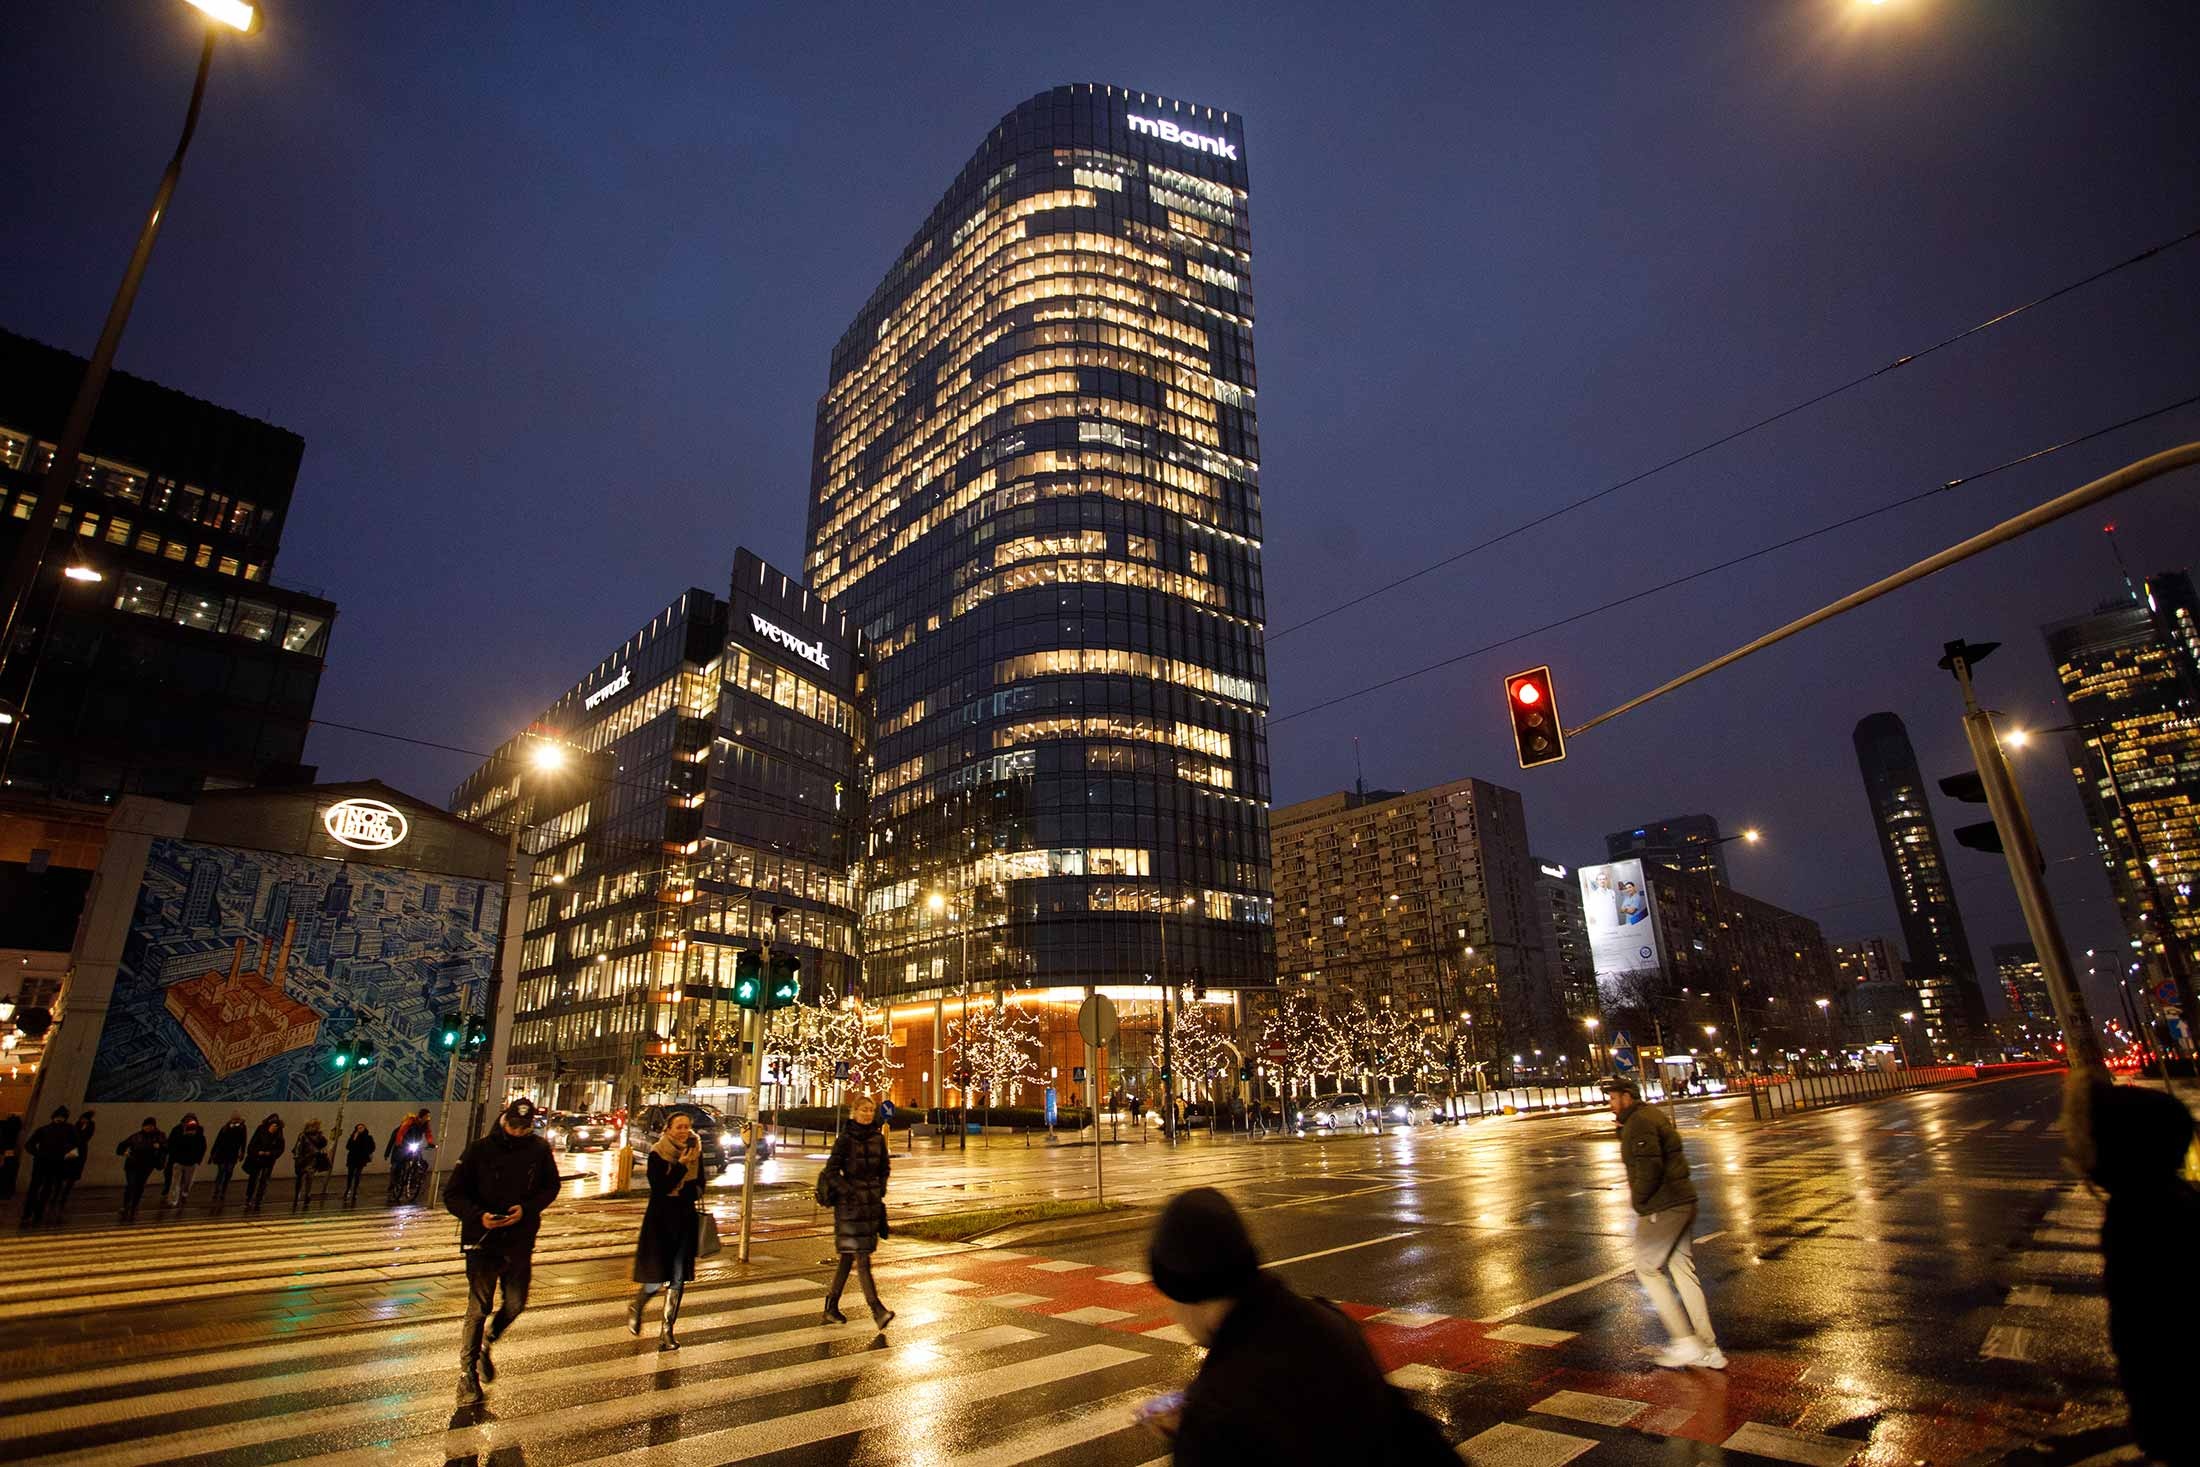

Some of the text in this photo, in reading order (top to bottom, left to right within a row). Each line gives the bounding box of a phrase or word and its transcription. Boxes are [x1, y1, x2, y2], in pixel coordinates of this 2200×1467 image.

[1127, 114, 1237, 161] mBank
[750, 613, 830, 671] wework
[585, 665, 631, 711] wework
